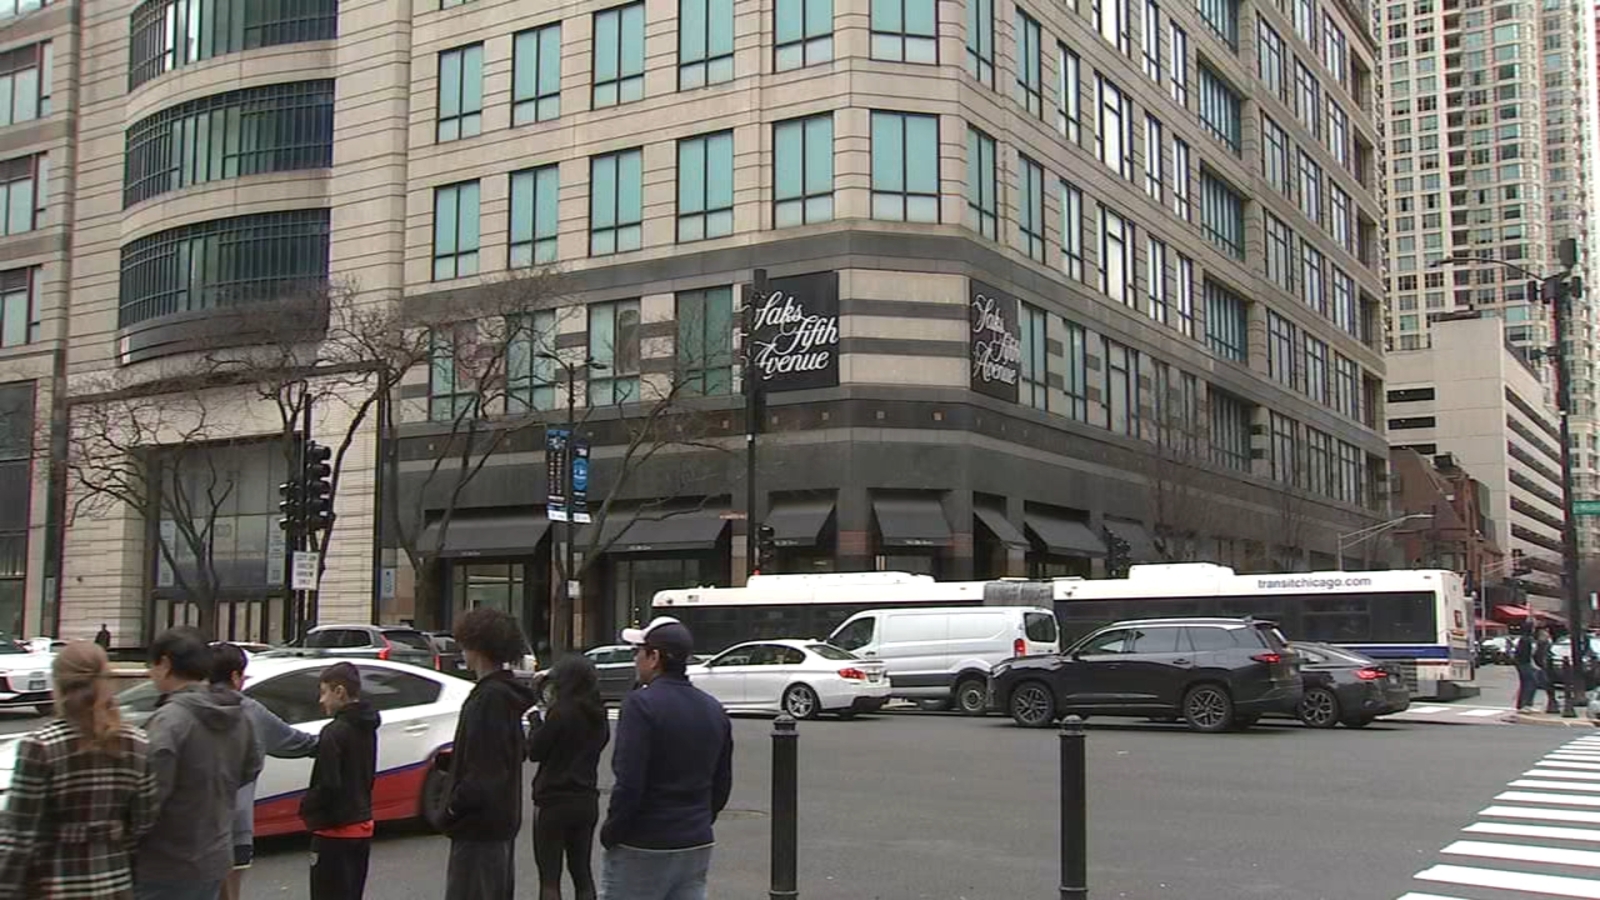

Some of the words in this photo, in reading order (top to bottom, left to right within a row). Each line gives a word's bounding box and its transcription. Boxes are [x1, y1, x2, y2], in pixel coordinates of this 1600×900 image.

[749, 291, 803, 332] Saks
[972, 294, 1005, 333] Saks
[747, 341, 829, 379] Avenue
[972, 341, 1016, 385] Avenue
[1257, 578, 1372, 590] transitchicago.com
